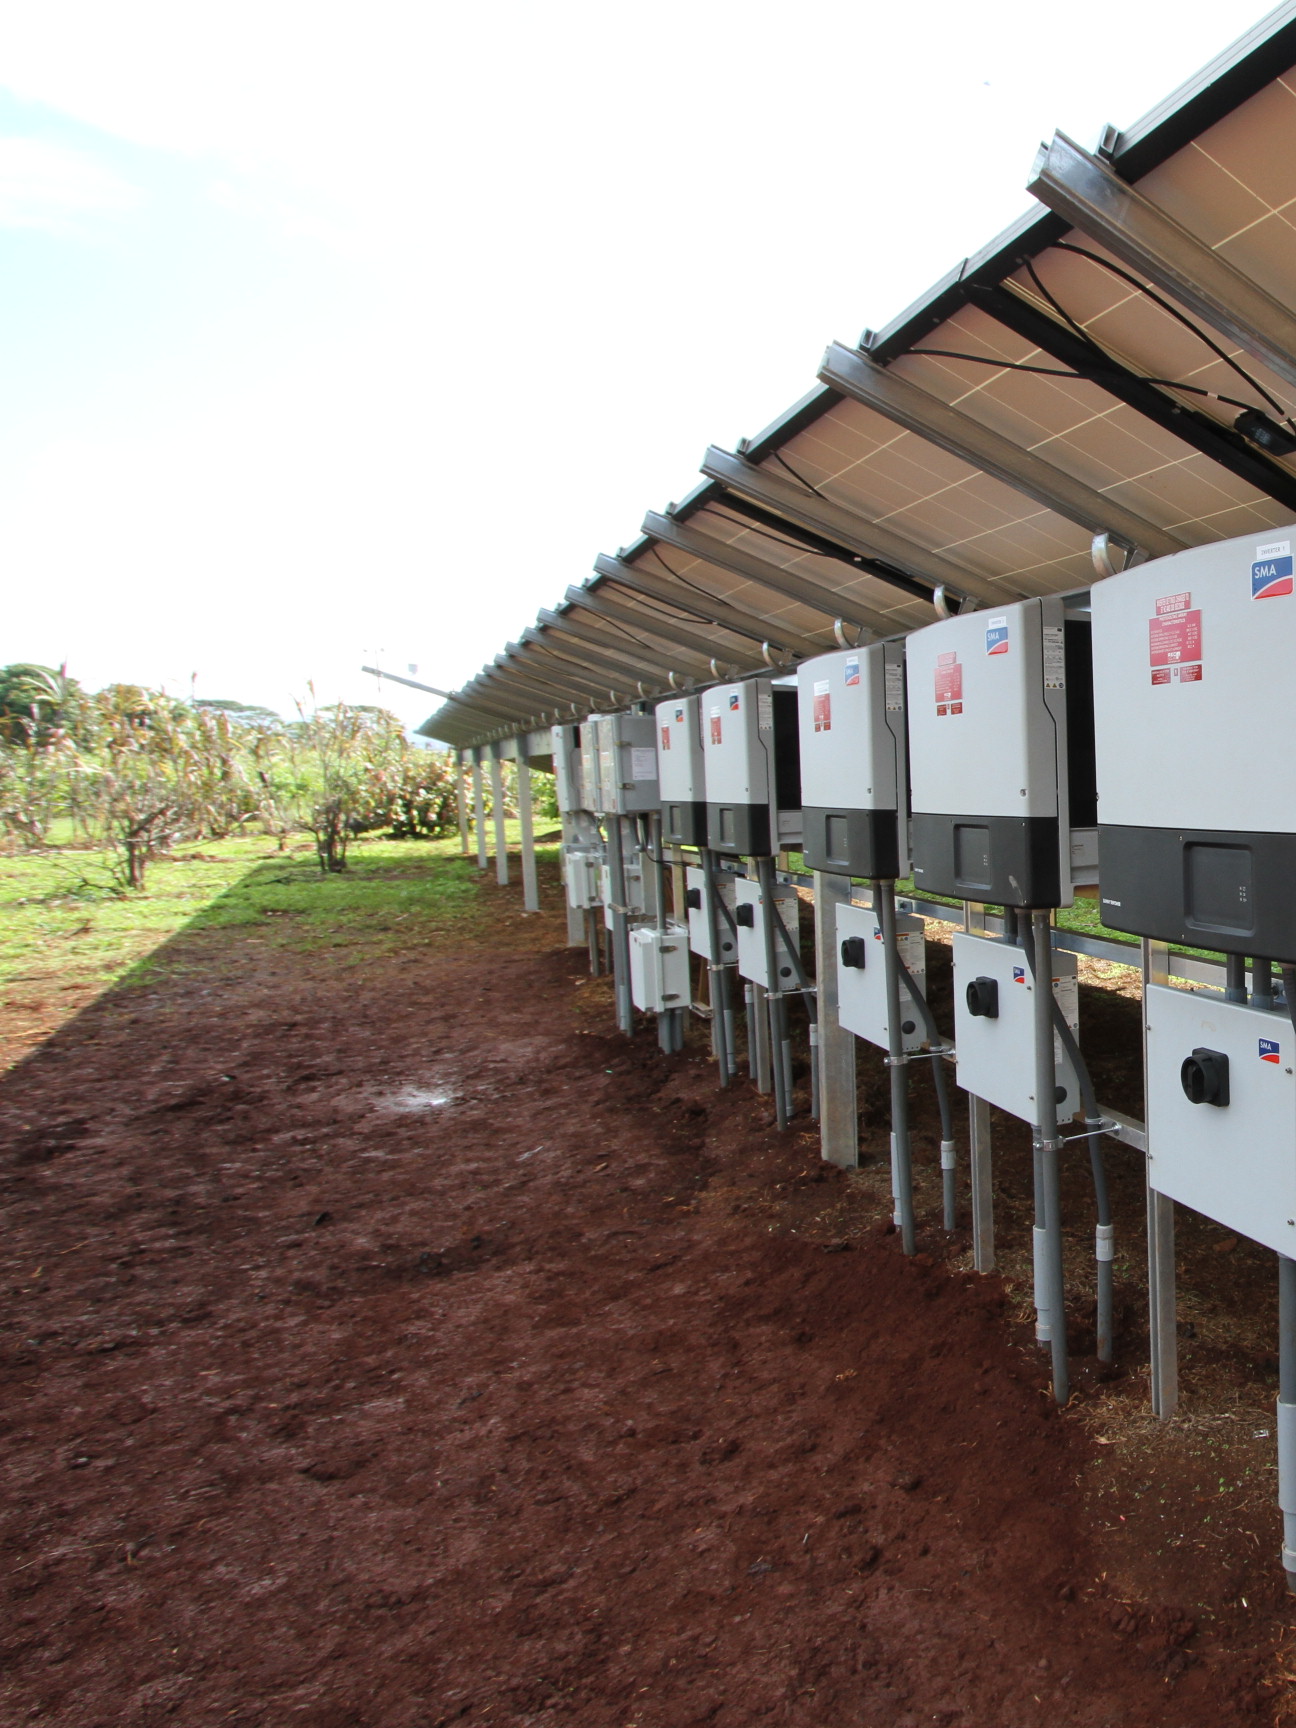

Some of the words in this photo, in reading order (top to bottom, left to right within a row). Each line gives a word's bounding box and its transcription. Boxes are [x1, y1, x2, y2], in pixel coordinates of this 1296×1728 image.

[1254, 564, 1277, 579] SMA
[987, 632, 1000, 642] SMA
[1260, 1040, 1272, 1050] SMA
